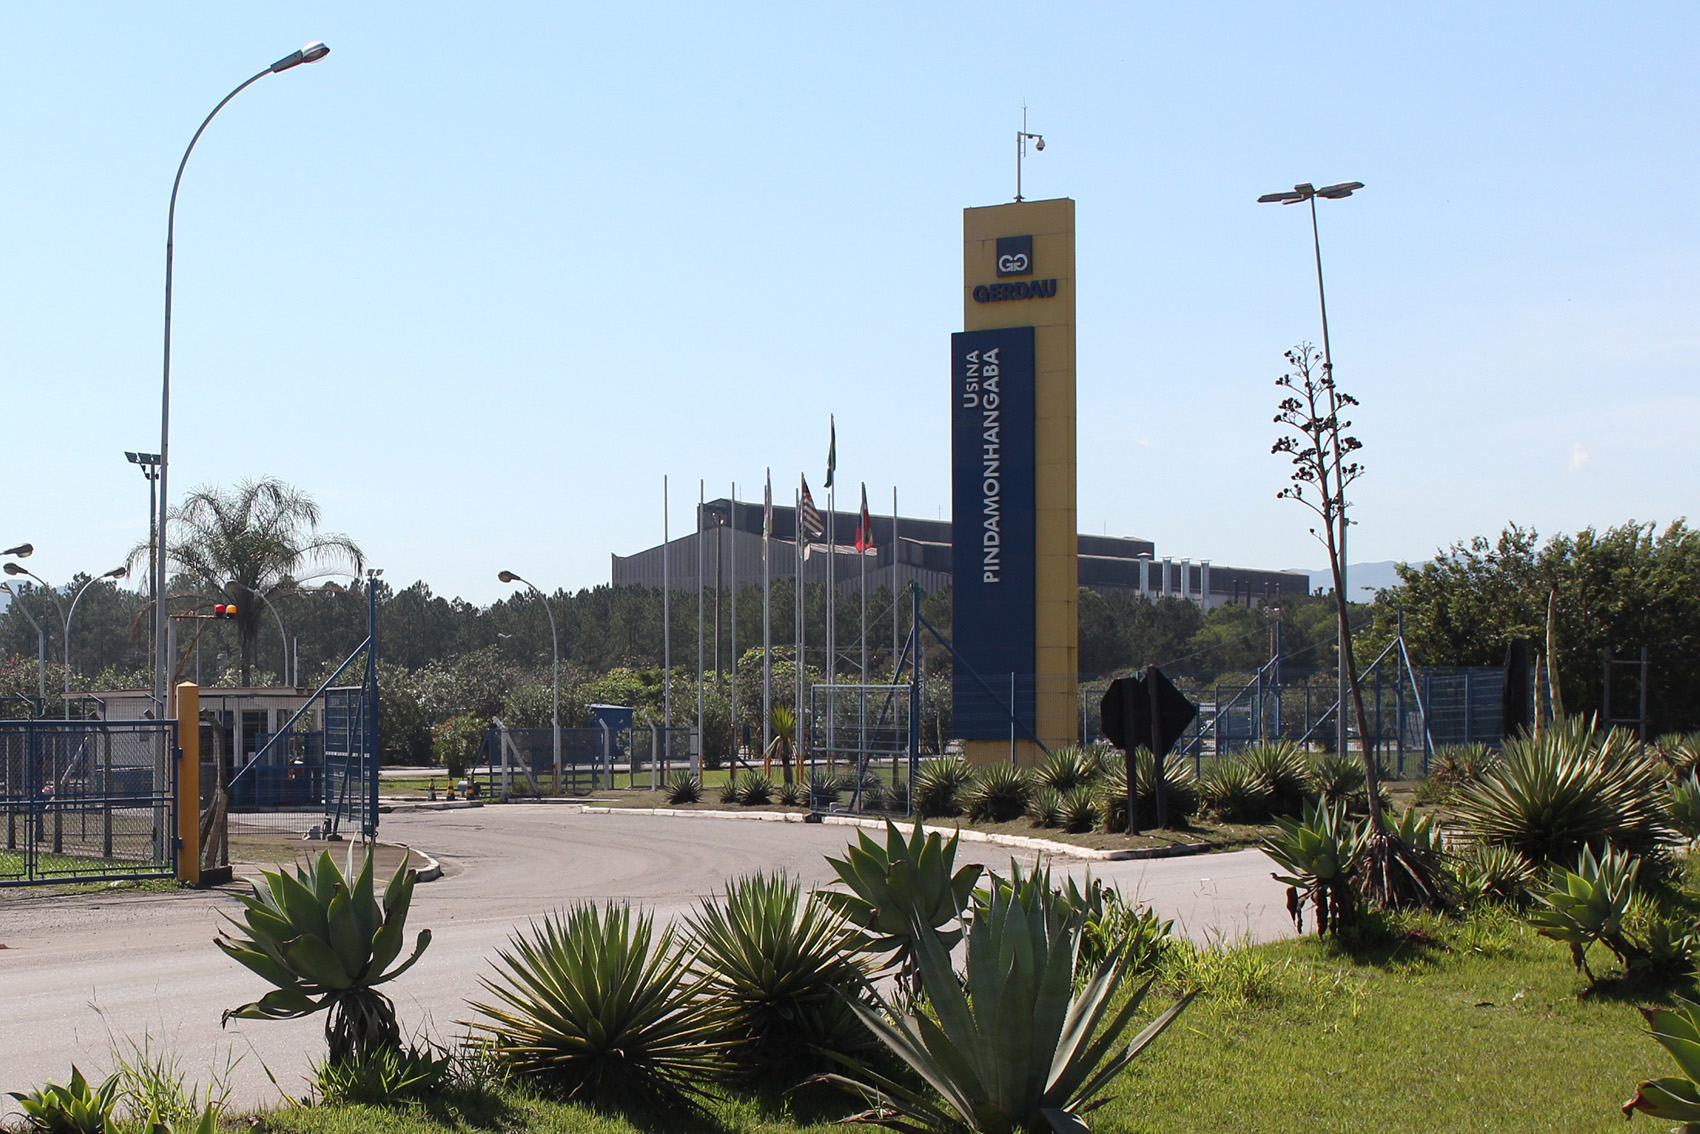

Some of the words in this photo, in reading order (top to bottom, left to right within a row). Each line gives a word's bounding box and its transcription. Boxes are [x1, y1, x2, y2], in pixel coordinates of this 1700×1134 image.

[973, 279, 1057, 303] GERDAU
[963, 350, 979, 408] USINA
[983, 348, 1000, 583] PINDAMONHANGABA
